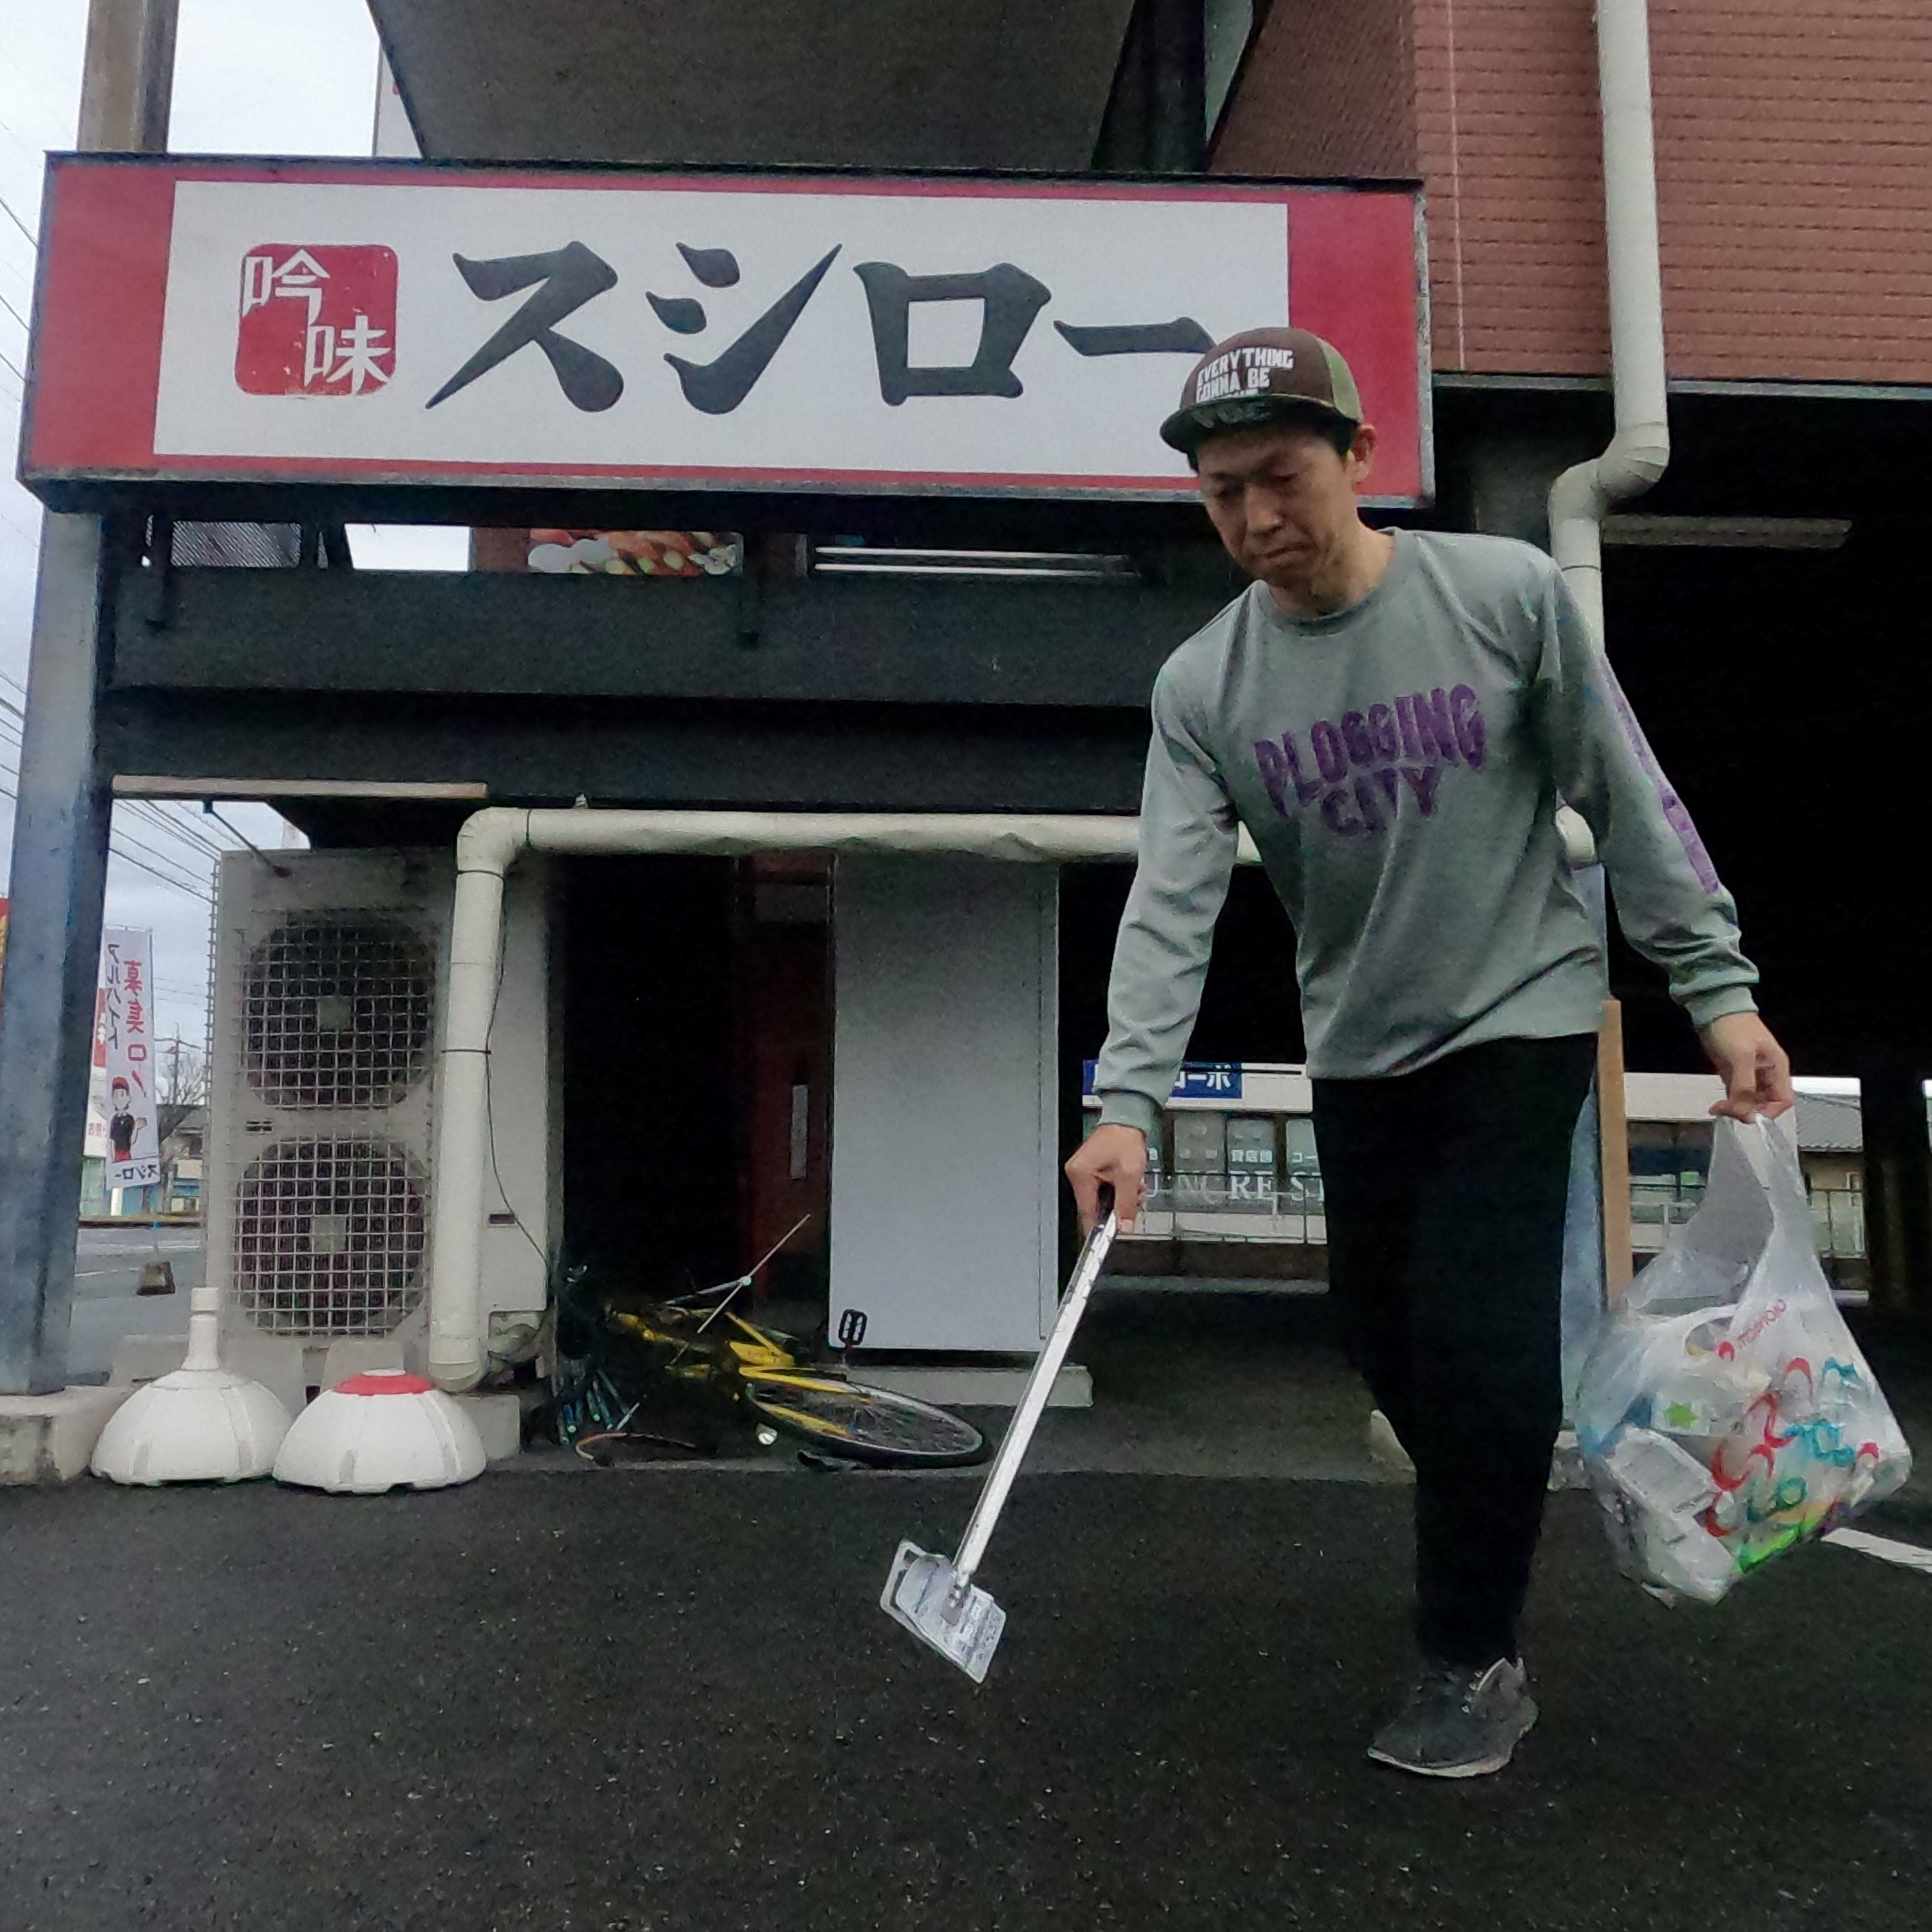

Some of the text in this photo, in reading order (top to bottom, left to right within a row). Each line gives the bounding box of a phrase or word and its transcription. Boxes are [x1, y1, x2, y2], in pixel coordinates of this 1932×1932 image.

[242, 249, 392, 394] 吟味
[425, 240, 1217, 415] スシロー
[1247, 367, 1271, 388] BE
